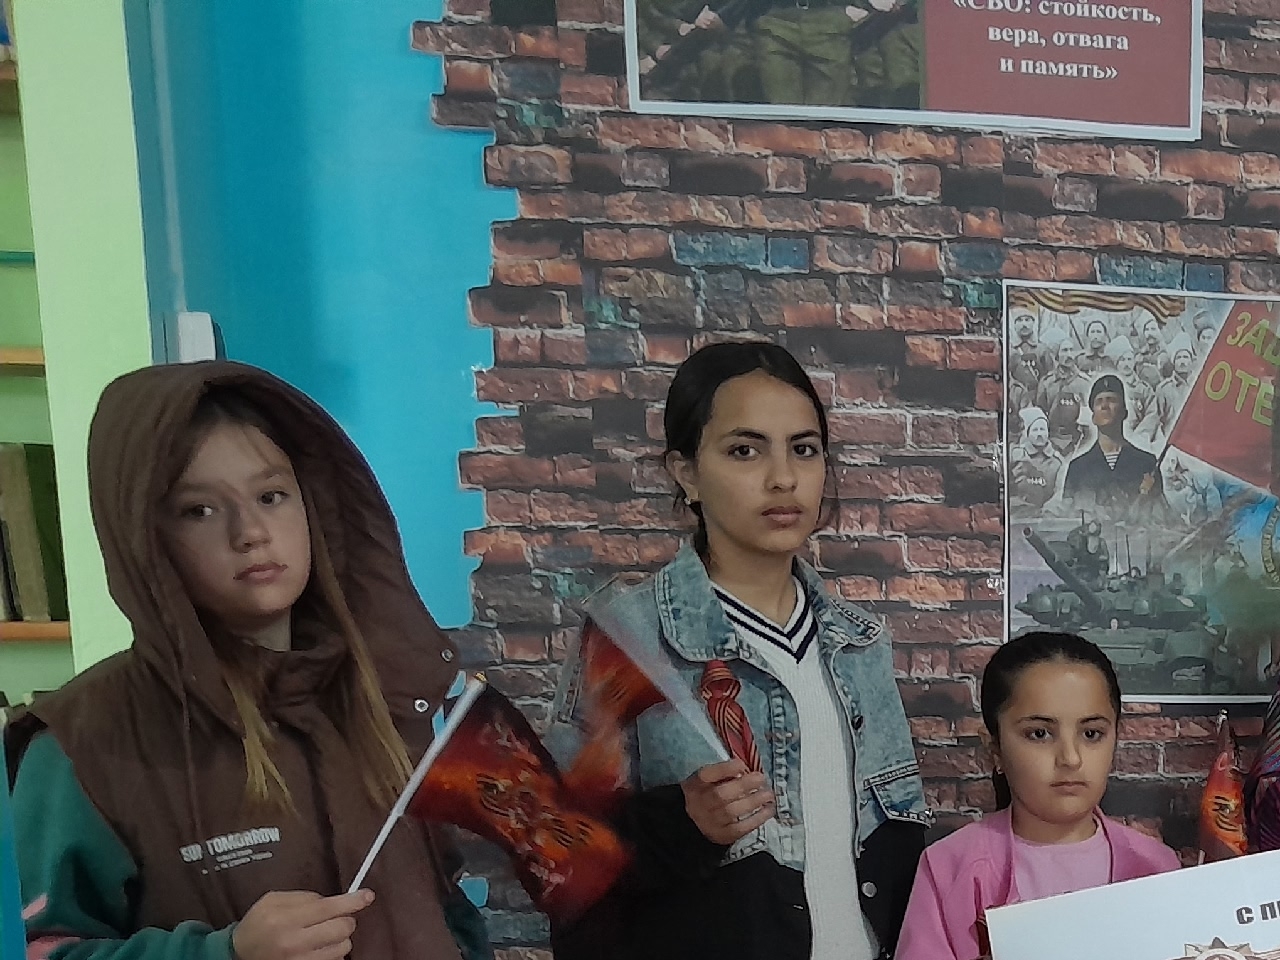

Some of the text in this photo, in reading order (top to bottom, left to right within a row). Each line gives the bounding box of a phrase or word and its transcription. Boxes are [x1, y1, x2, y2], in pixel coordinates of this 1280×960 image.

[1038, 0, 1161, 25] стойкость,
[987, 26, 1129, 51] вера, отвага
[999, 57, 1118, 80] и память»
[1235, 905, 1255, 925] С
